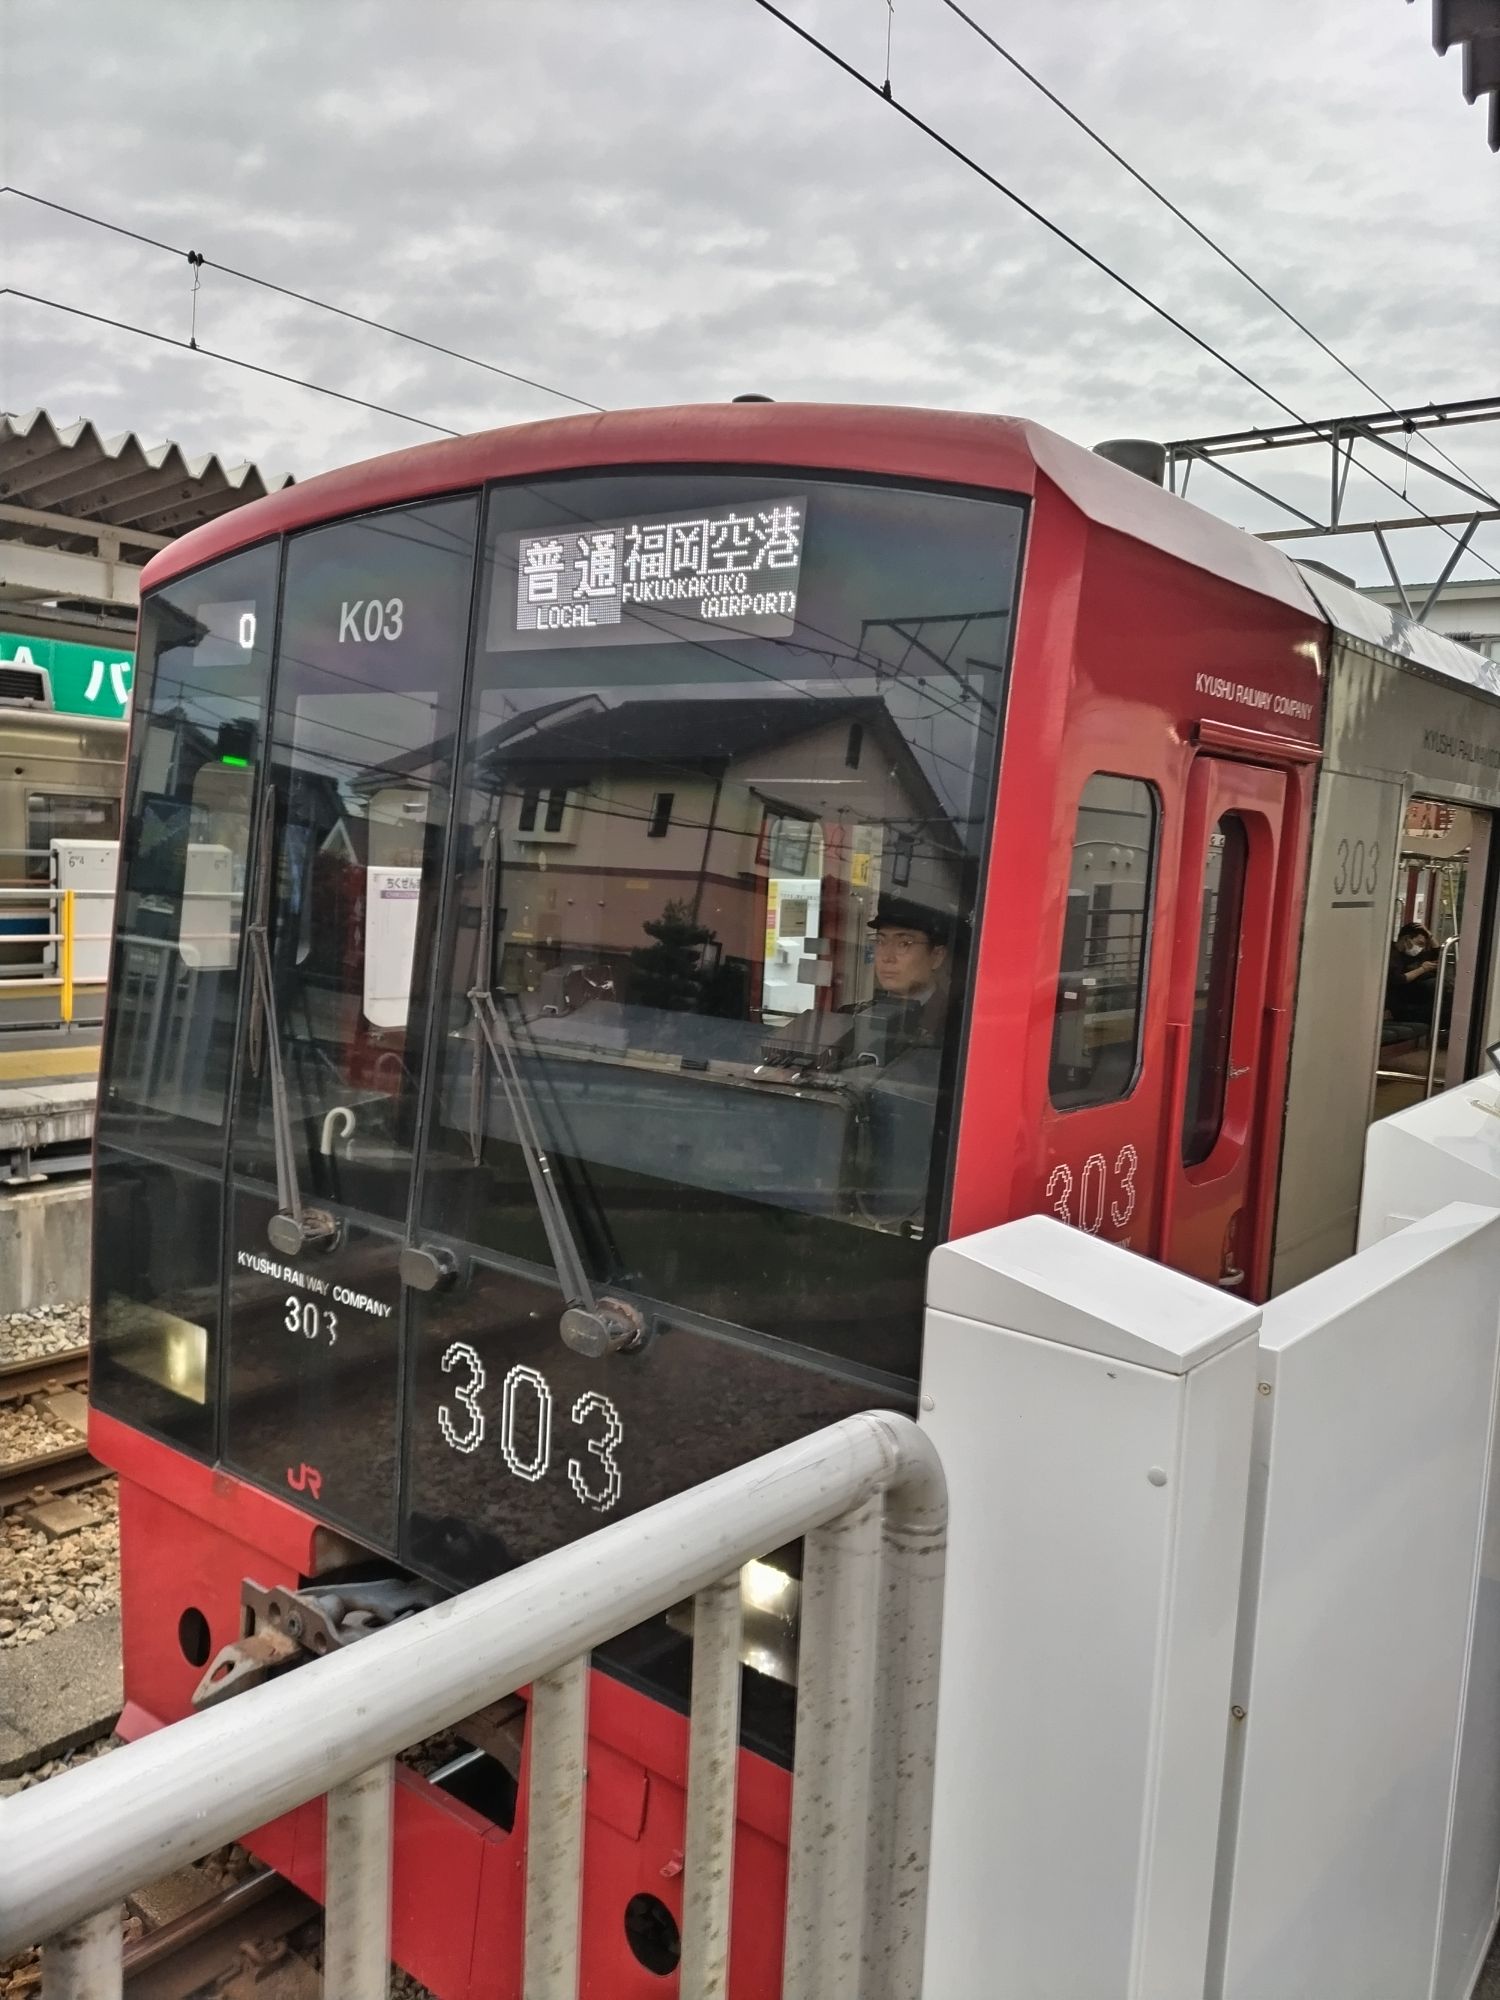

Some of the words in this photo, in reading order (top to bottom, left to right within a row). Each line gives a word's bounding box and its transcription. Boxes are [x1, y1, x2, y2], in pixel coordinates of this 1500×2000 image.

[523, 531, 617, 603] 普通
[623, 505, 800, 582] 福岡空港
[622, 572, 748, 603] FUKUOKAKUKO
[338, 597, 404, 643] K03
[536, 603, 598, 630] LOCAL
[1195, 672, 1236, 701] KYUSHU
[1236, 684, 1273, 710] RAILWAY
[1273, 695, 1314, 720] COMPANY
[1333, 838, 1380, 895] 303
[1046, 1144, 1138, 1236] 303
[237, 1250, 283, 1279] KYUSHU
[283, 1267, 330, 1297] RAILWAY
[332, 1285, 393, 1318] COMPANY
[283, 1295, 339, 1347] 303
[438, 1342, 623, 1512] 303
[287, 1462, 323, 1500] JR
